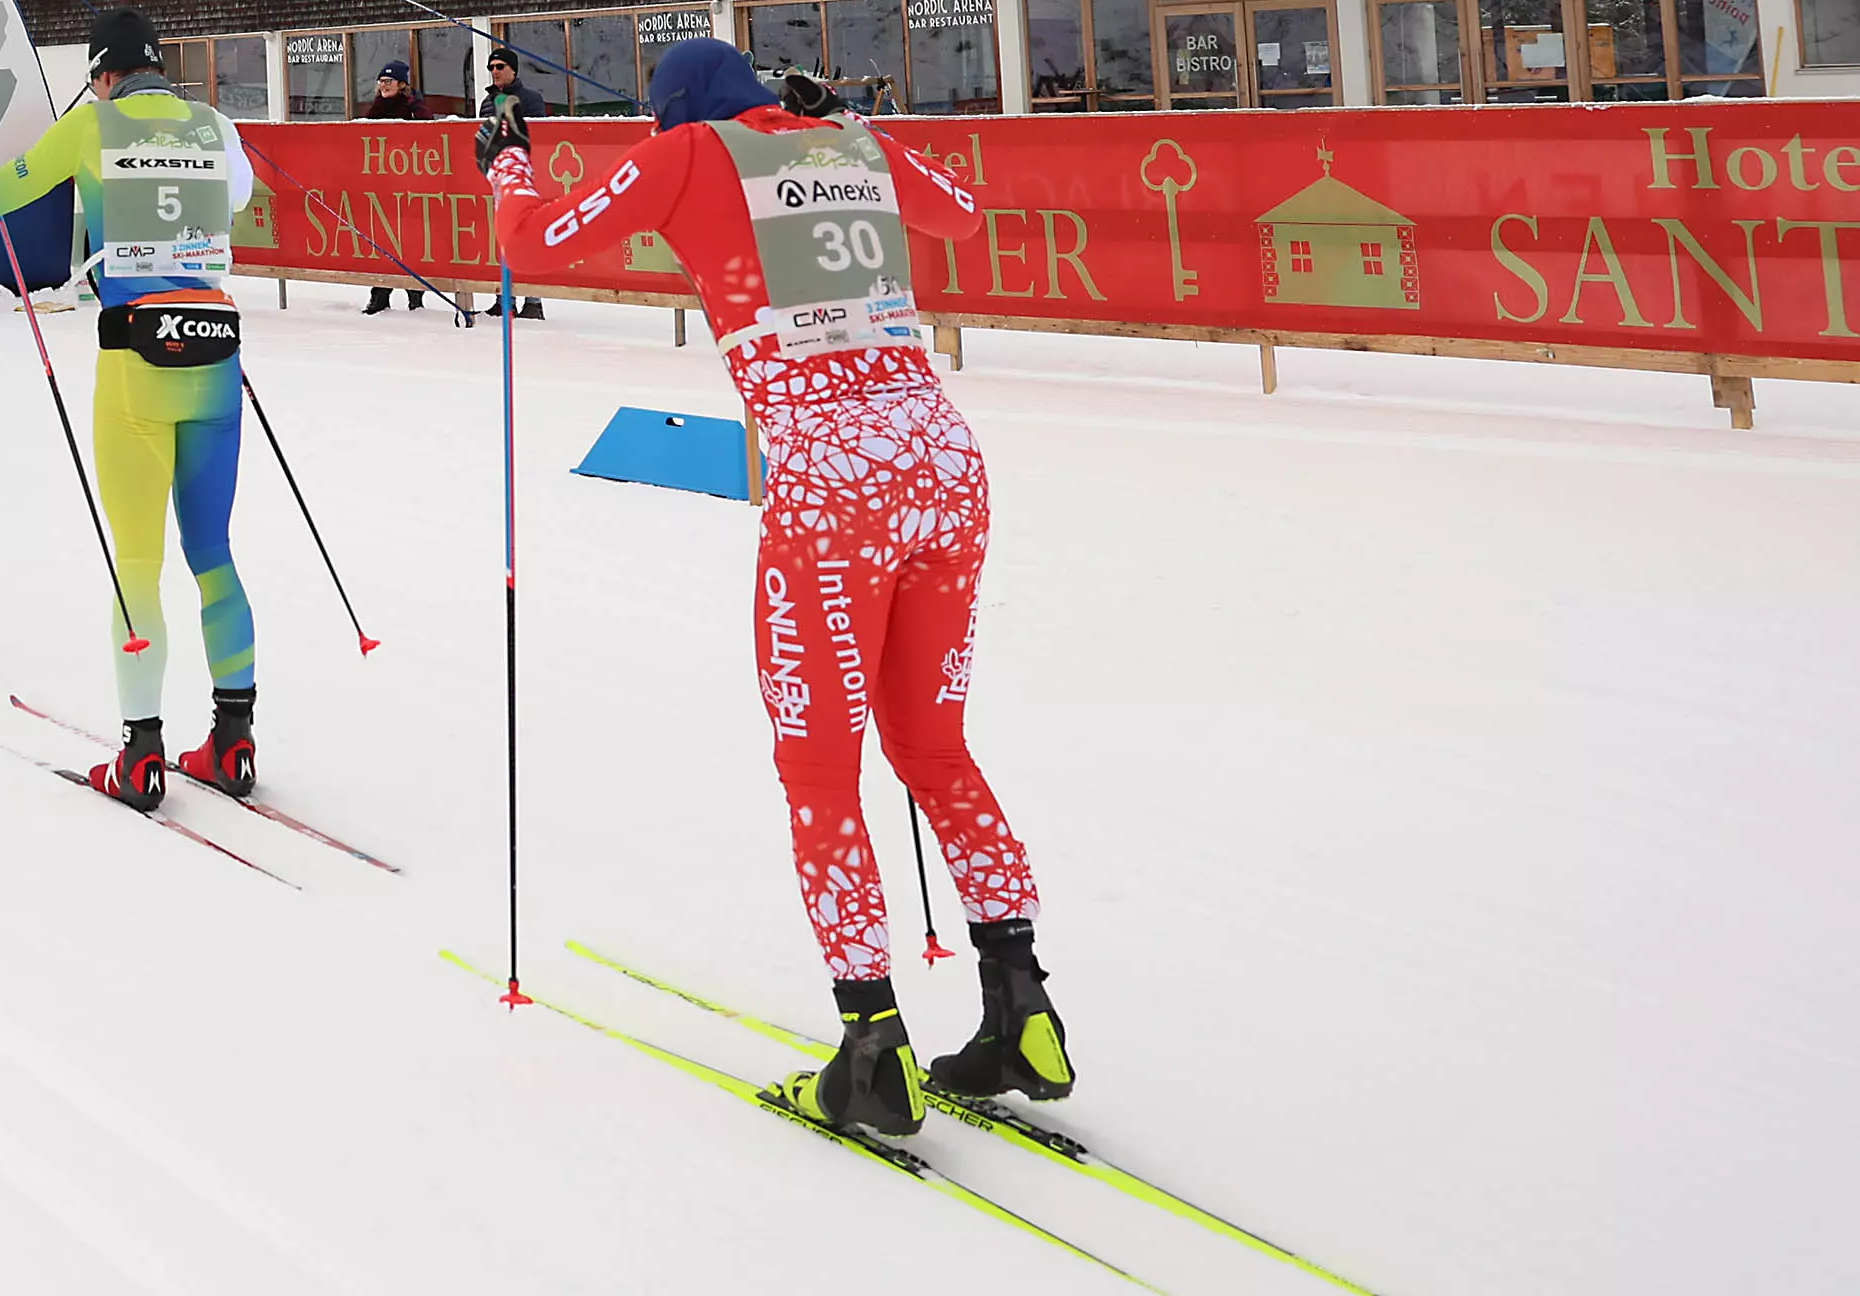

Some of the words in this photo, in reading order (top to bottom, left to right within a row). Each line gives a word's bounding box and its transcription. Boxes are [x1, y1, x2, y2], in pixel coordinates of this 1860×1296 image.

[638, 13, 673, 32] NORDIC
[676, 12, 711, 29] ARENA
[908, 19, 927, 30] BAR
[929, 14, 994, 28] RESTAURANT
[287, 37, 314, 53] NORDIC
[316, 38, 344, 52] ARENA
[638, 33, 655, 44] BAR
[656, 30, 712, 43] RESTAURANT
[1185, 34, 1218, 50] BAR
[288, 54, 300, 63] BAR
[301, 53, 343, 63] RESTAURANT
[1175, 56, 1233, 72] BISTRO
[361, 133, 452, 176] Hotel
[812, 179, 882, 203] Anexis
[156, 185, 183, 222] 5
[543, 159, 641, 247] GSG
[116, 245, 155, 258] CMP
[812, 219, 884, 272] 30
[792, 308, 848, 328] CMP
[182, 320, 236, 339] COXA
[763, 566, 811, 742] TRENTINO
[816, 559, 868, 734] Internorm
[922, 1093, 995, 1133] SCHER
